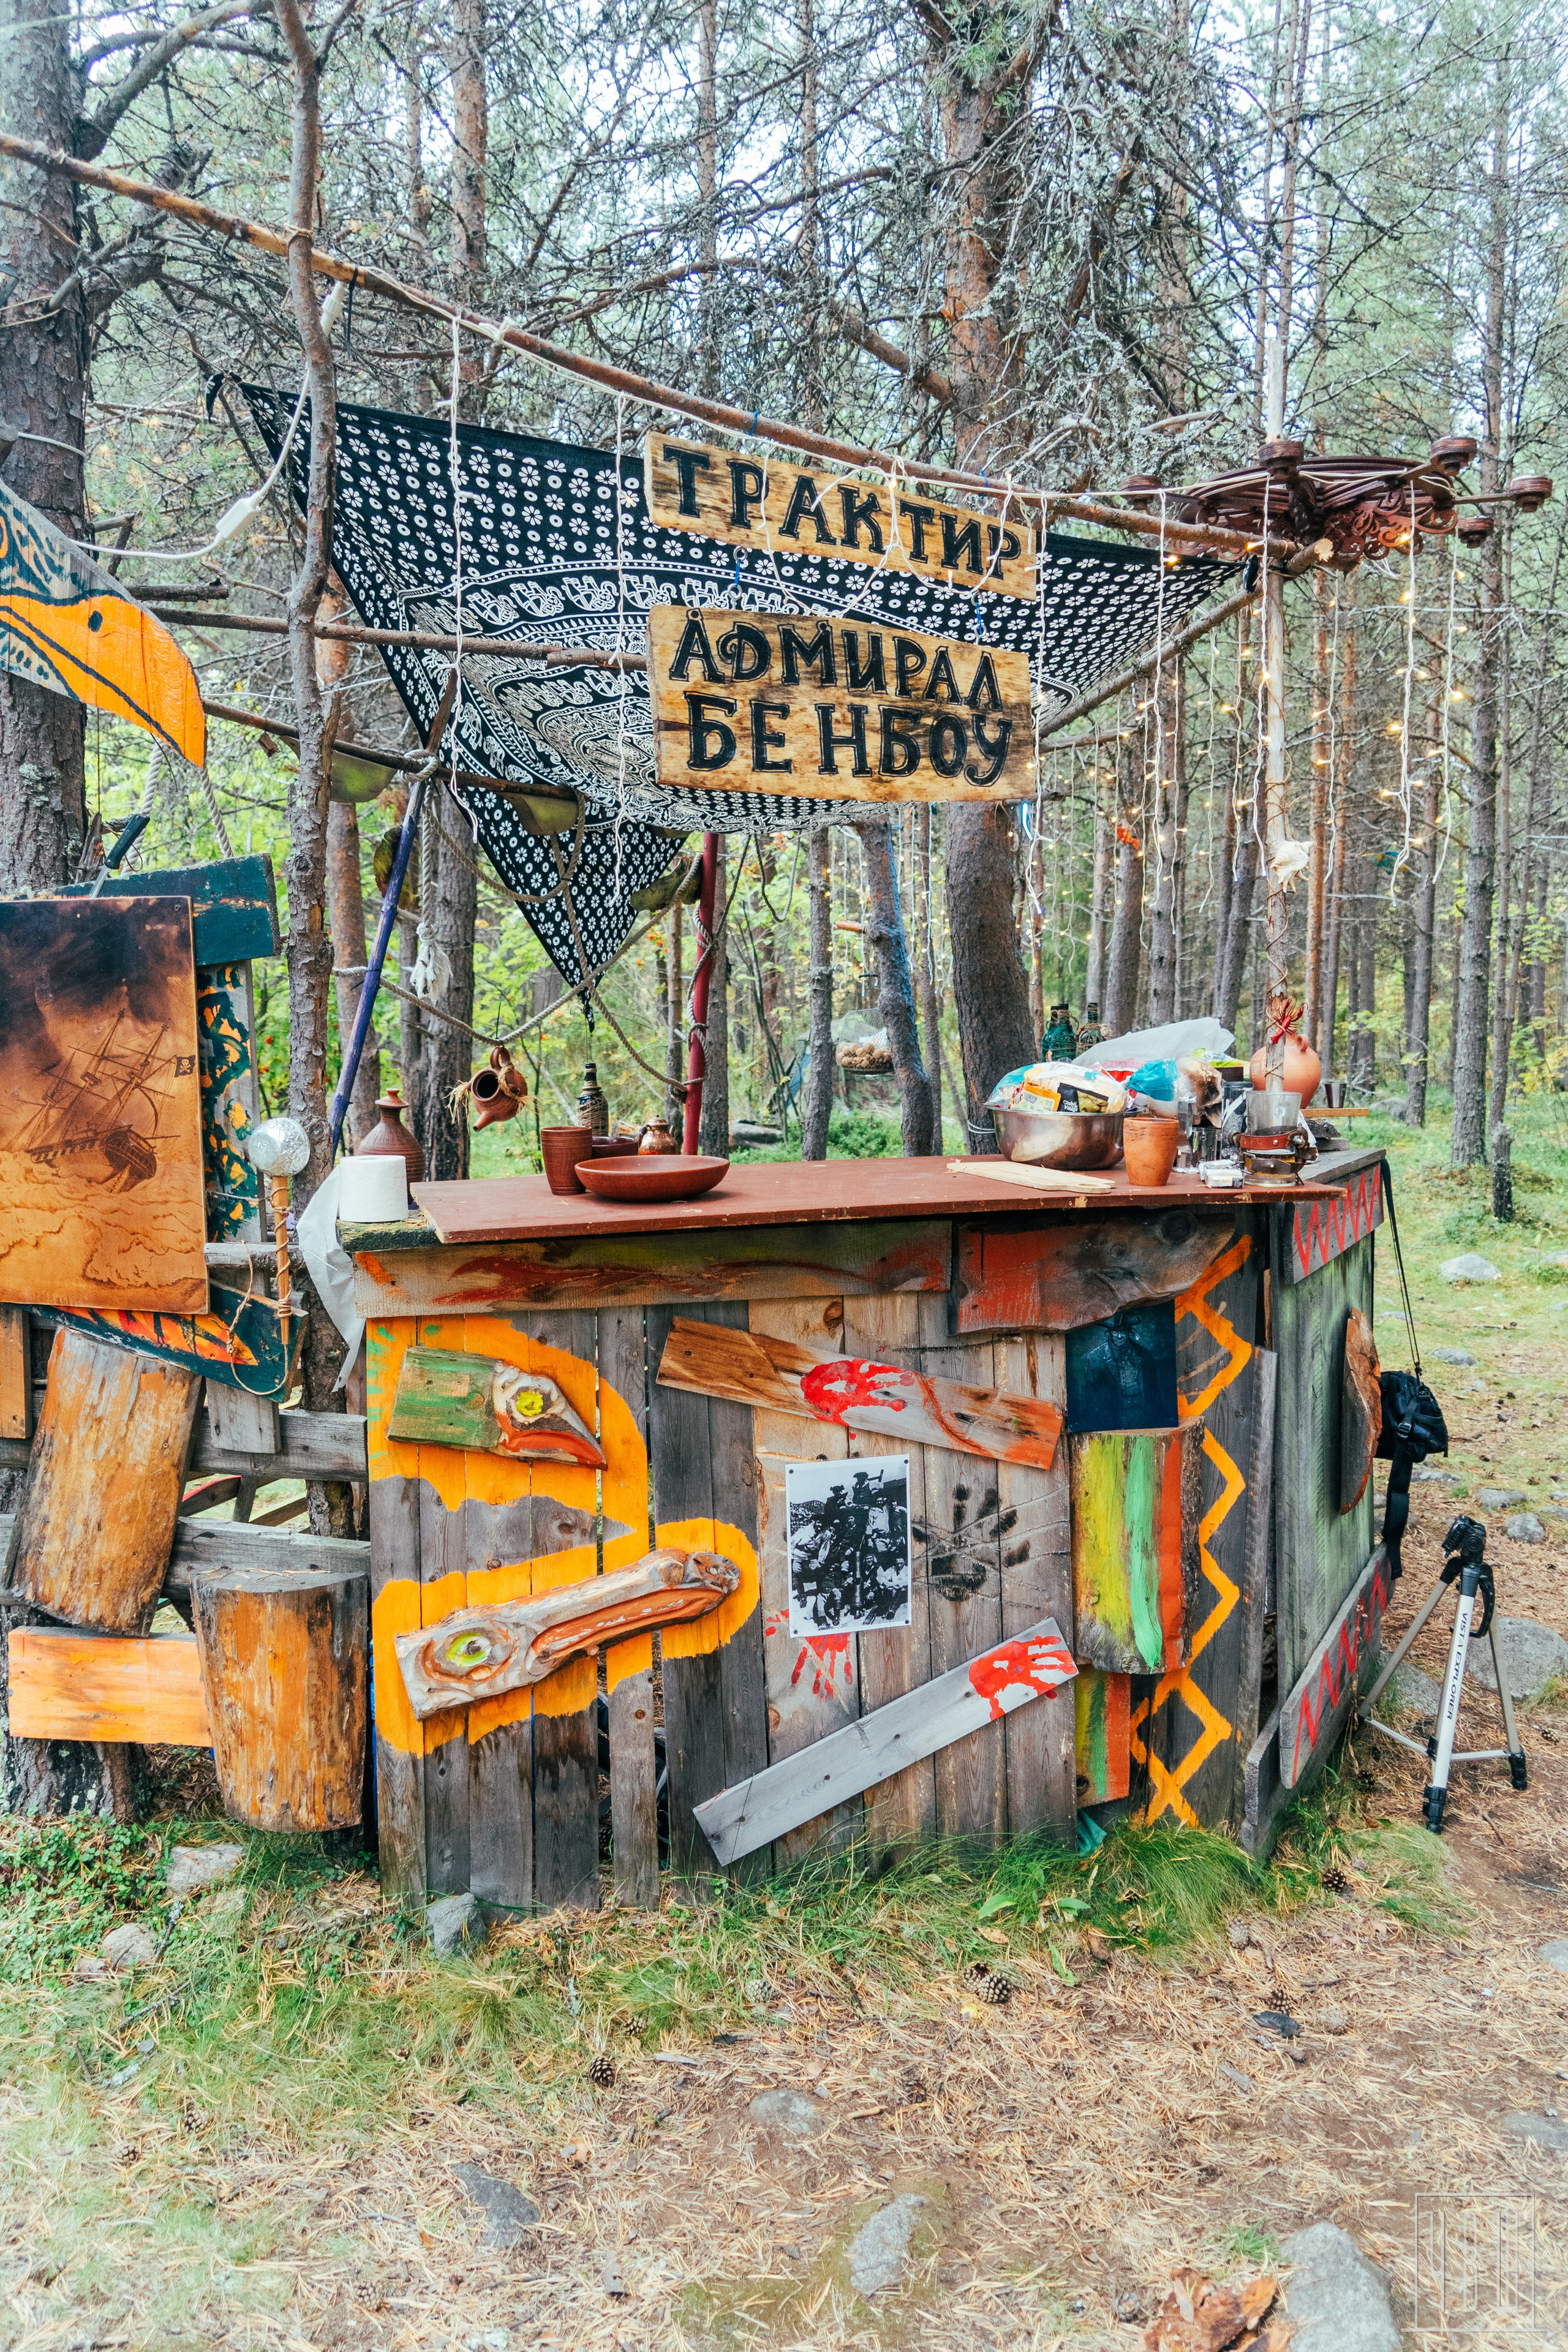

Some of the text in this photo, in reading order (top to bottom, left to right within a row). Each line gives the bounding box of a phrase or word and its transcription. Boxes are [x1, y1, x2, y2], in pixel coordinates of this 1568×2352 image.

[663, 443, 1022, 580] ТРАКТИР
[669, 608, 1003, 712] АДМИРАЛ
[682, 691, 1012, 787] БЕНБОУ
[1064, 1104, 1078, 1112] Village
[1447, 1612, 1468, 1721] VISTA EXPLORER
